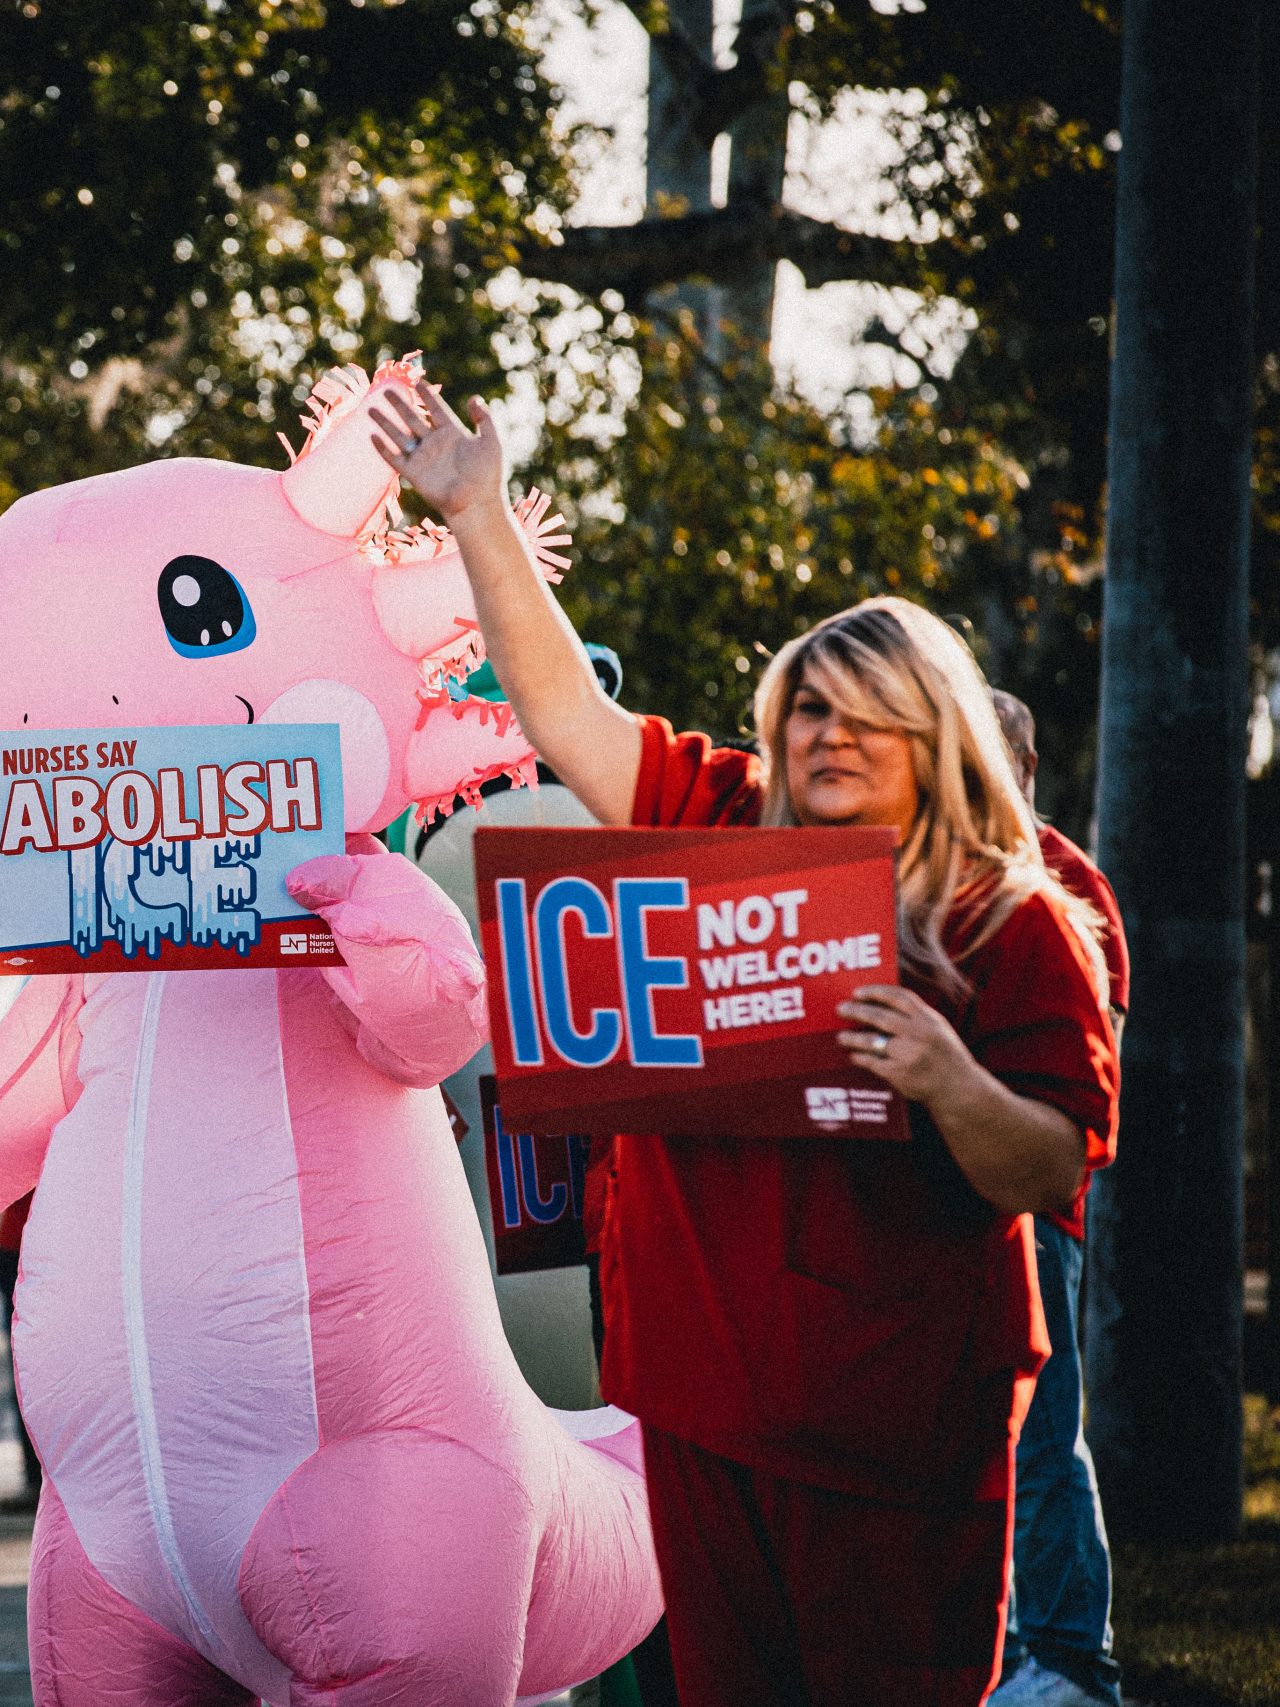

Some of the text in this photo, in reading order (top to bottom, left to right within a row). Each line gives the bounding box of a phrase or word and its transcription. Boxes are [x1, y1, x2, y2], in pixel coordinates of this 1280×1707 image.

[2, 740, 137, 776] NURSES SAY
[0, 757, 322, 856] ABOLISH
[68, 834, 261, 959] ICE
[696, 889, 808, 950] NOT
[495, 876, 705, 1068] ICE
[698, 933, 882, 990] WELCOME
[703, 986, 805, 1032] HERE!
